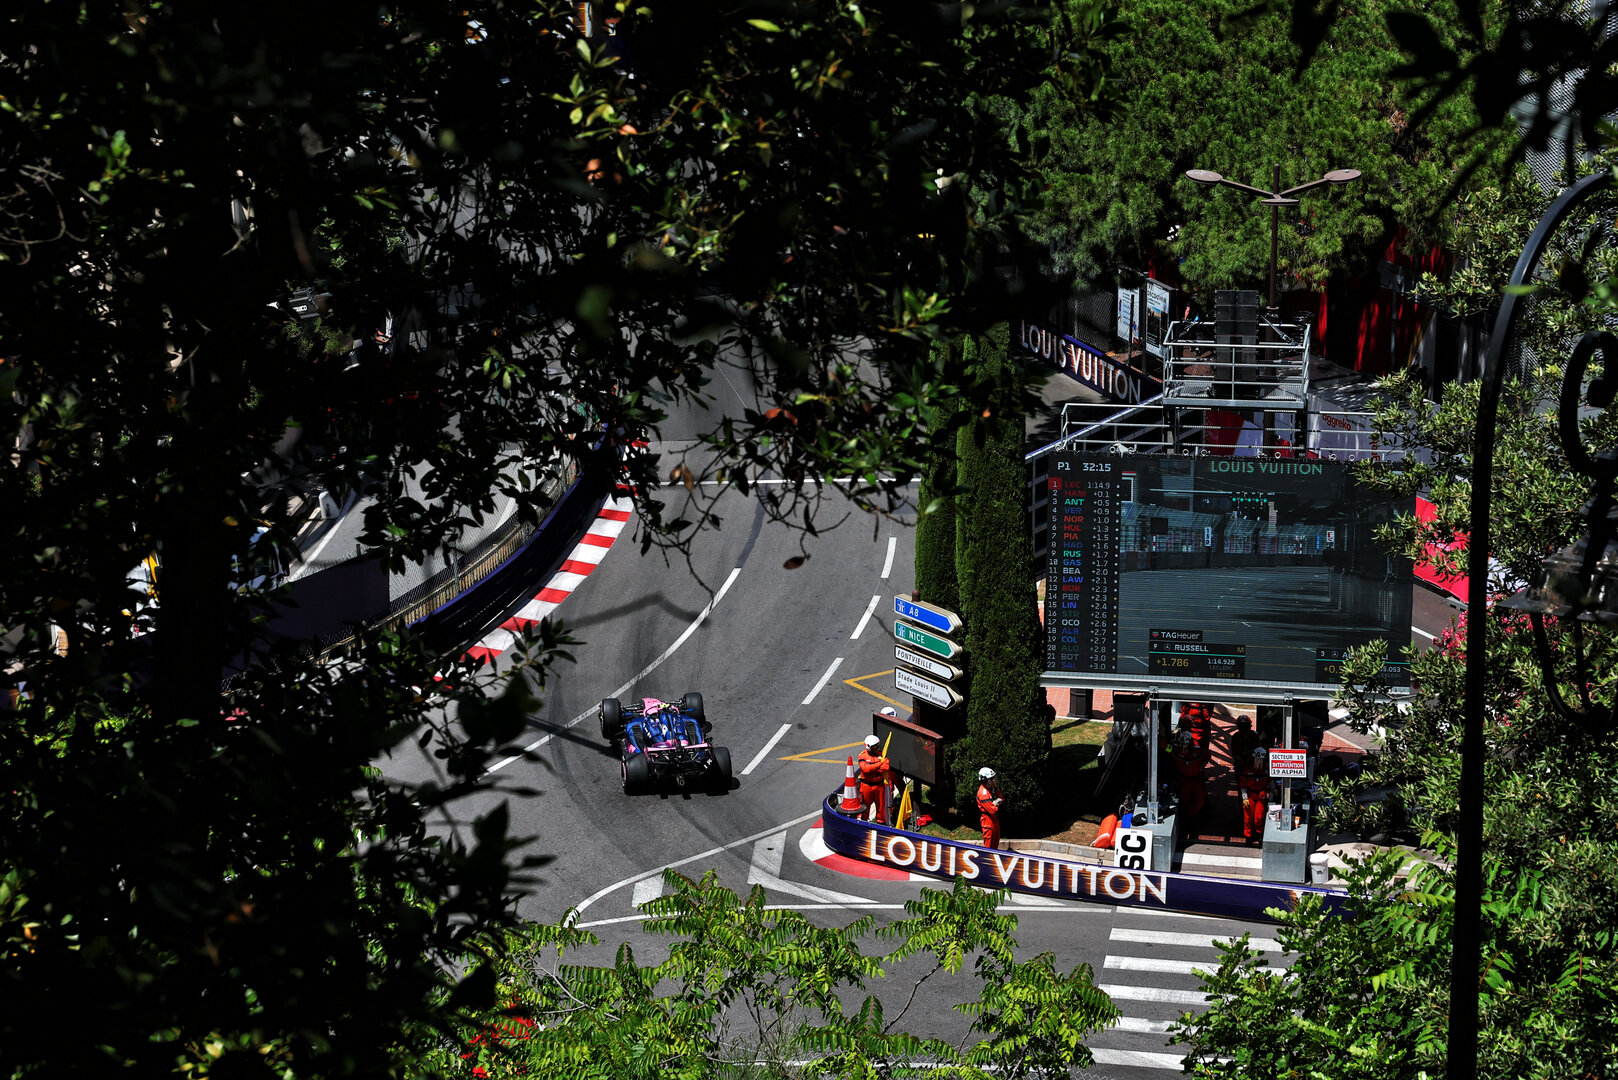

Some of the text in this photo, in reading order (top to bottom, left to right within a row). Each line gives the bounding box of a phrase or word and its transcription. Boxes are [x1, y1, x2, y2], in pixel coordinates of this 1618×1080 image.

[1021, 319, 1141, 404] LOUIS VUITTON
[1322, 413, 1352, 431] aggreko
[1057, 462, 1112, 472] P1 32:15
[1211, 460, 1323, 475] LOUIS VUITTON
[909, 606, 919, 617] A8
[908, 630, 925, 644] NICE
[1174, 644, 1209, 652] RUSSELL
[898, 650, 932, 670] FONTVIEILLE
[1156, 657, 1189, 668] +1.786
[898, 672, 912, 683] Stade
[914, 680, 929, 690] Louis
[910, 686, 930, 698] Commercial
[869, 829, 1167, 905] LOUIS VUITTON
